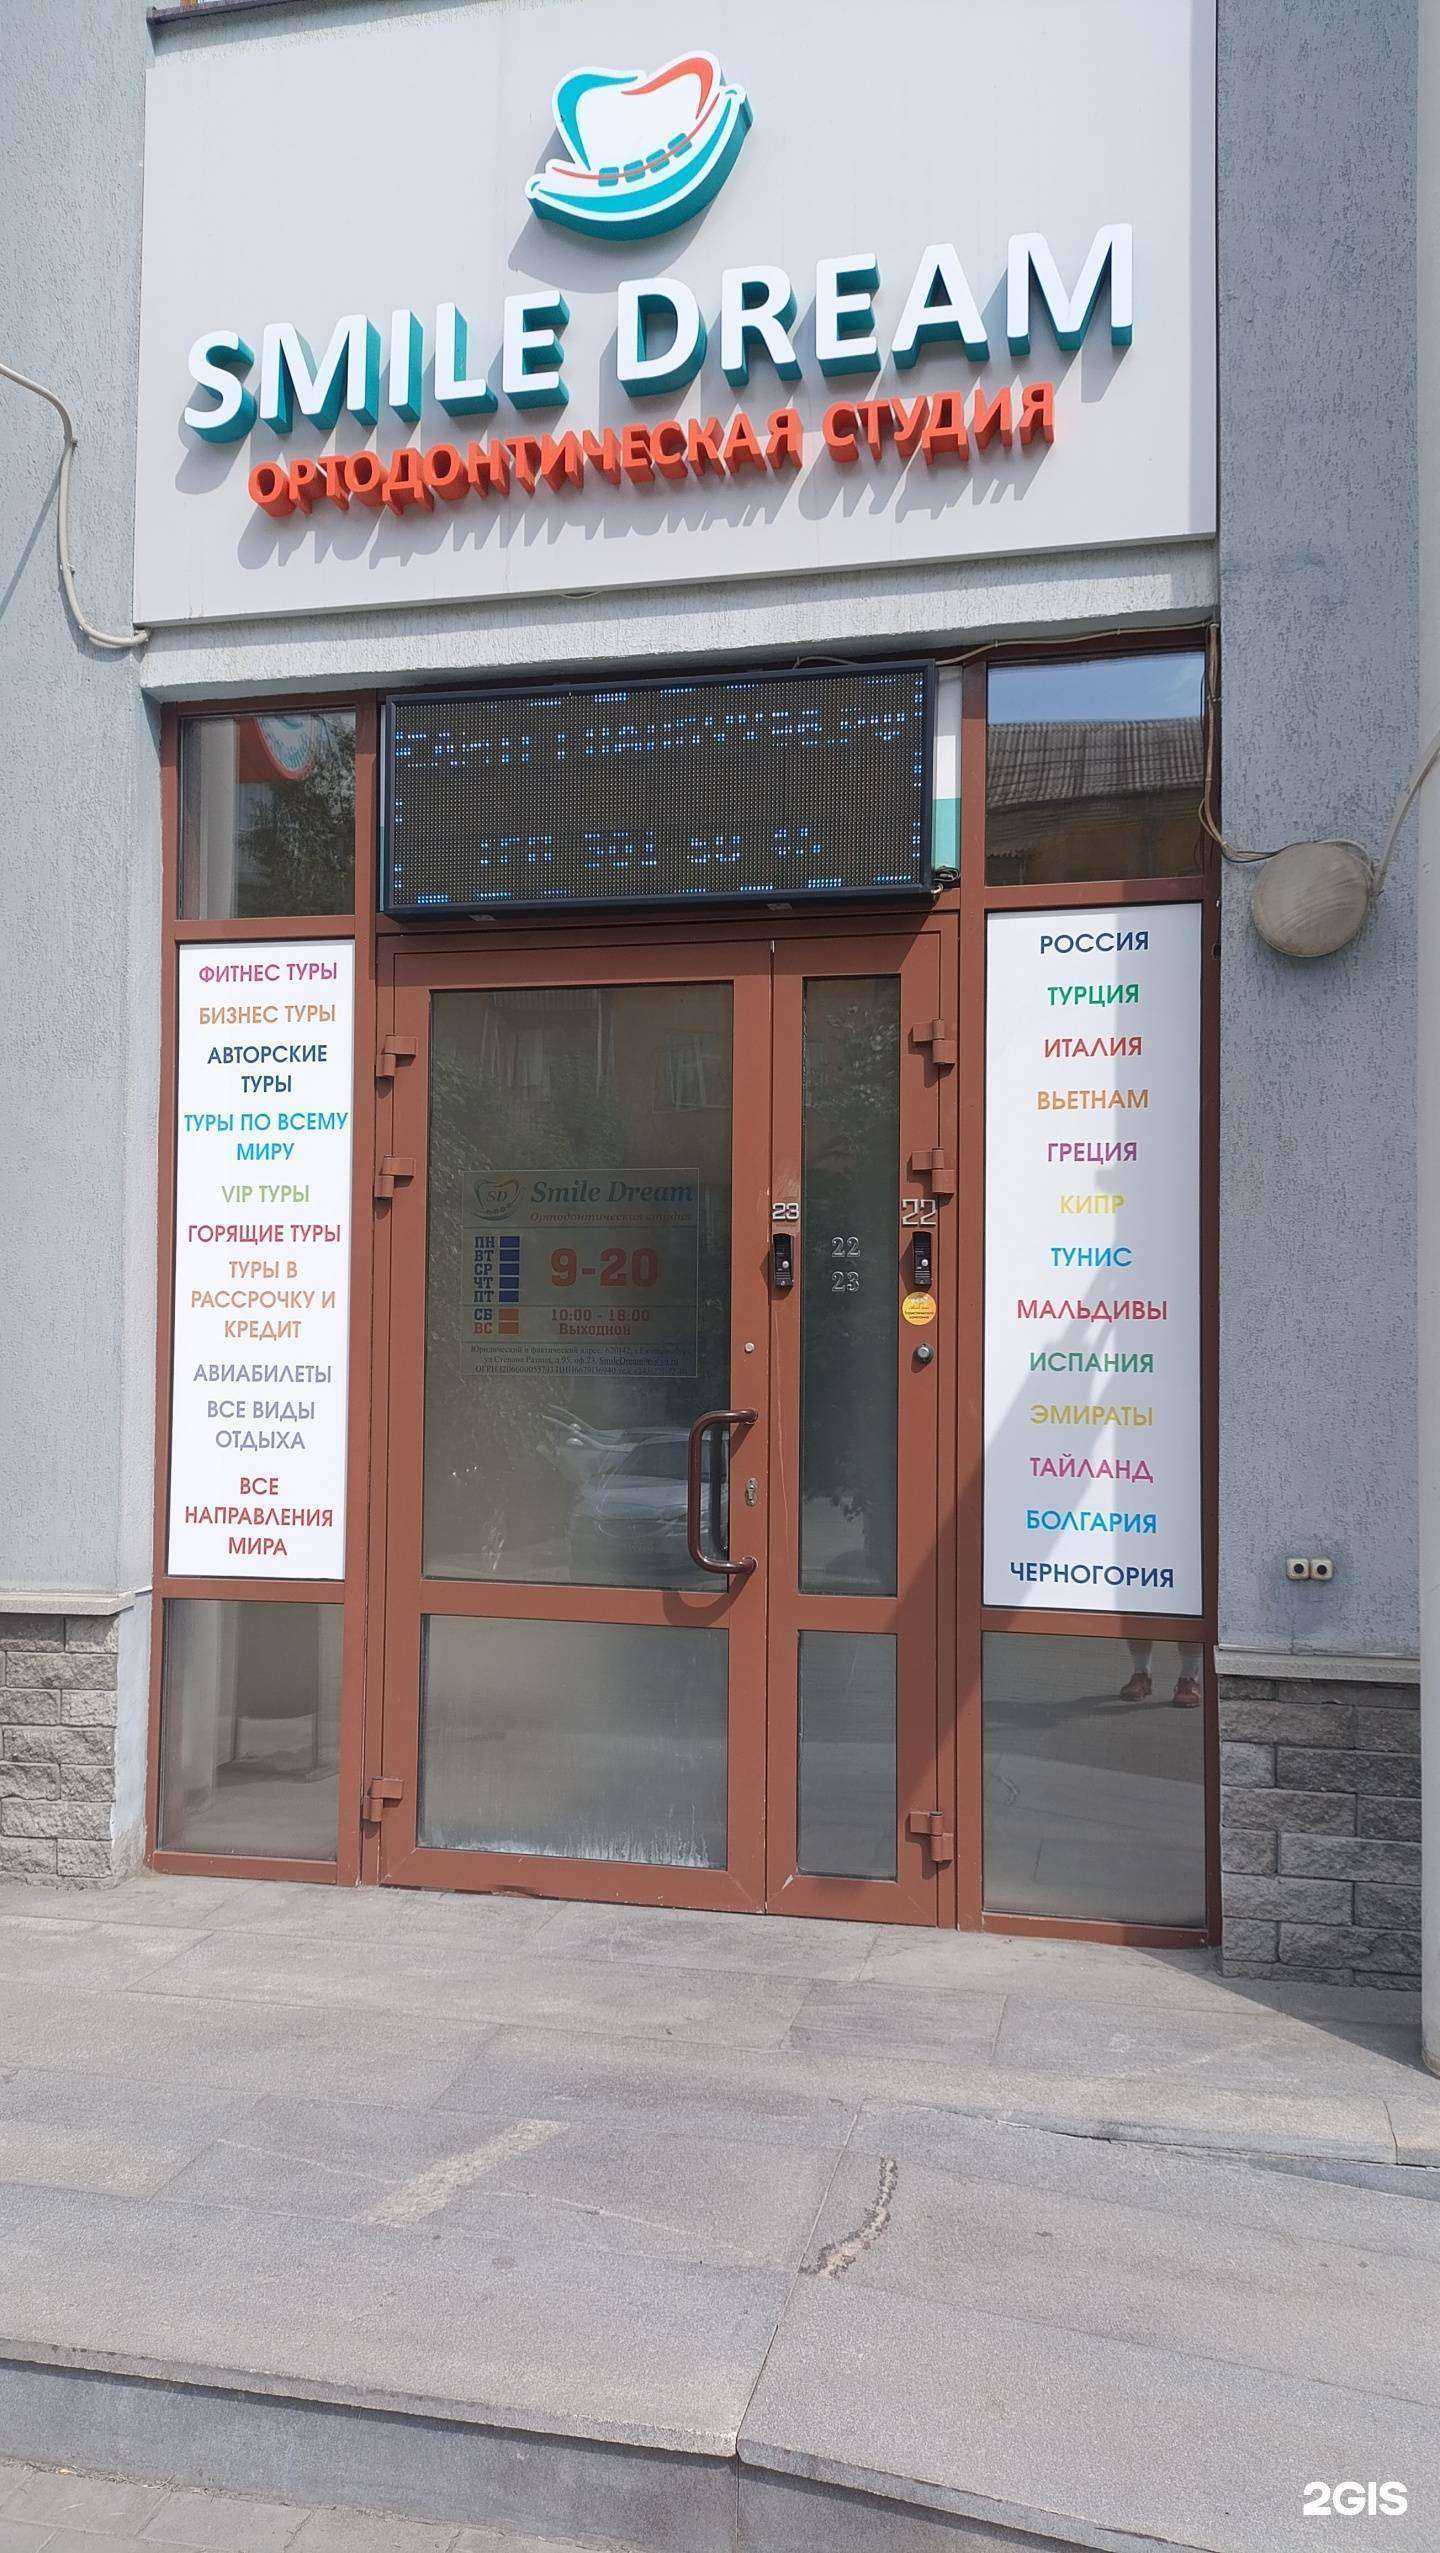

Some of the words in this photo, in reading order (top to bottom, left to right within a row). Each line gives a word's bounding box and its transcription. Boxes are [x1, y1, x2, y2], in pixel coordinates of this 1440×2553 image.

[184, 289, 568, 443] SMILE
[616, 223, 1134, 396] DREAM
[246, 409, 802, 516] ОРТОДОНТИЧЕСКАЯ
[821, 382, 1055, 467] СТУДИЯ
[1040, 931, 1150, 954] РОССИЯ
[198, 964, 280, 982] ФИТНЕС
[286, 962, 338, 981] ТУРЫ
[1047, 984, 1139, 1007] ТУРЦИЯ
[199, 1005, 278, 1024] БИЗНЕС
[284, 1004, 336, 1023] ТУРЫ
[208, 1044, 328, 1064] АВТОРСКИЕ
[1044, 1037, 1142, 1058] ИТАЛИЯ
[241, 1075, 292, 1093] ТУРЫ
[1037, 1089, 1149, 1110] ВЬЕТНАМ
[184, 1114, 234, 1132] ТУРЫ
[240, 1114, 271, 1131] ПО
[278, 1112, 348, 1130] ВСЕМУ
[236, 1143, 294, 1161] МИРУ
[1048, 1142, 1137, 1165] ГРЕЦИЯ
[222, 1186, 252, 1202] VIP
[259, 1185, 310, 1202] ТУРЫ
[531, 1180, 601, 1203] Smile
[608, 1181, 694, 1203] Dream
[772, 1203, 800, 1220] 23
[902, 1199, 936, 1226] 22
[1060, 1195, 1125, 1214] КИПР
[188, 1225, 284, 1245] ГОРЯЩИЕ
[290, 1224, 340, 1242] ТУРЫ
[474, 1236, 495, 1248] ПН
[474, 1250, 494, 1262] ВТ
[832, 1237, 860, 1257] 22
[1051, 1247, 1132, 1267] ТУНИС
[229, 1261, 279, 1279] ТУРЫ
[287, 1261, 298, 1279] В
[474, 1263, 492, 1275] СР
[551, 1248, 659, 1287] 9-20
[474, 1277, 493, 1289] ЧТ
[832, 1271, 860, 1292] 23
[191, 1290, 315, 1309] РАССРОЧКУ
[322, 1291, 336, 1309] И
[474, 1290, 494, 1302] ПТ
[474, 1308, 493, 1320] СБ
[551, 1309, 591, 1322] 10:00
[608, 1309, 650, 1322] 18:00
[1017, 1299, 1168, 1323] МАЛЬДИВЫ
[224, 1320, 302, 1340] КРЕДИТ
[474, 1322, 493, 1334] ВС
[1030, 1352, 1154, 1373] ИСПАНИЯ
[193, 1364, 332, 1383] АВИАБИЛЕТЫ
[208, 1401, 245, 1418] ВСЕ
[253, 1401, 315, 1422] ВИДЫ
[1030, 1404, 1153, 1426] ЭМИРАТЫ
[216, 1430, 306, 1451] ОТДЫХА
[1030, 1453, 1154, 1483] ТАЙЛАНД
[240, 1477, 279, 1495] ВСЕ
[185, 1506, 333, 1527] НАПРАВЛЕНИЯ
[1026, 1510, 1157, 1534] БОЛГАРИЯ
[228, 1537, 287, 1555] МИРА
[1010, 1562, 1174, 1588] ЧЕРНОГОРИЯ
